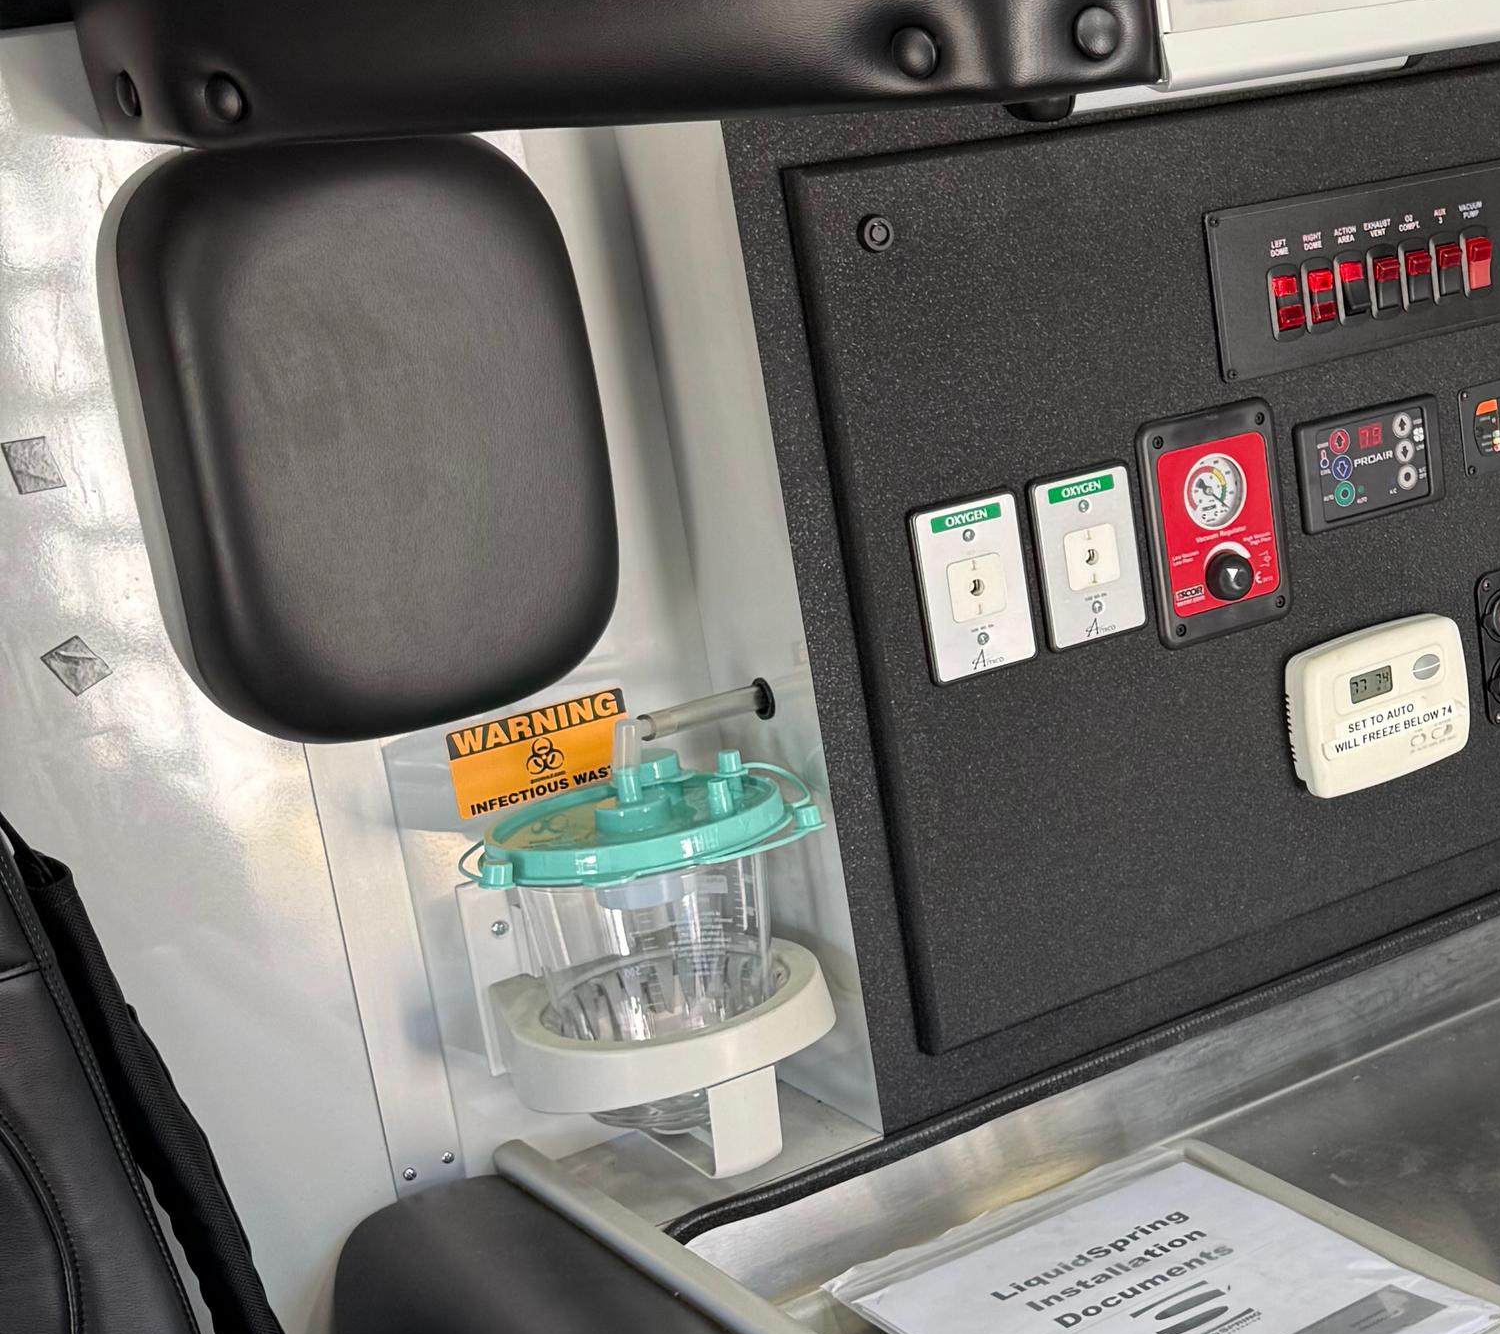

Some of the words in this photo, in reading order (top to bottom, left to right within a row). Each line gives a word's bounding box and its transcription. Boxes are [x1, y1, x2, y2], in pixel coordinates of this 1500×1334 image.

[1334, 226, 1356, 236] ACTION
[1364, 219, 1391, 231] EXHAUST
[1370, 228, 1386, 238] VENT
[1271, 239, 1286, 249] LEFT
[1338, 234, 1355, 244] AREA
[1354, 450, 1393, 467] PROAIR
[1061, 480, 1101, 499] OXYGEN
[945, 508, 988, 528] OXYGEN
[451, 691, 619, 756] WARNING
[1348, 719, 1367, 733] SET
[1371, 714, 1384, 726] TO
[1387, 703, 1414, 720] AUTO
[1335, 738, 1360, 753] WILL
[1362, 723, 1400, 744] FREEZE
[1404, 709, 1439, 730] BELOW
[1442, 705, 1452, 717] 74
[470, 778, 569, 816] INFECTIOUS
[573, 765, 613, 785] WAS
[990, 1211, 1190, 1301] LiquidSpring
[1025, 1229, 1207, 1312] Installation
[1053, 1244, 1234, 1329] Documents
